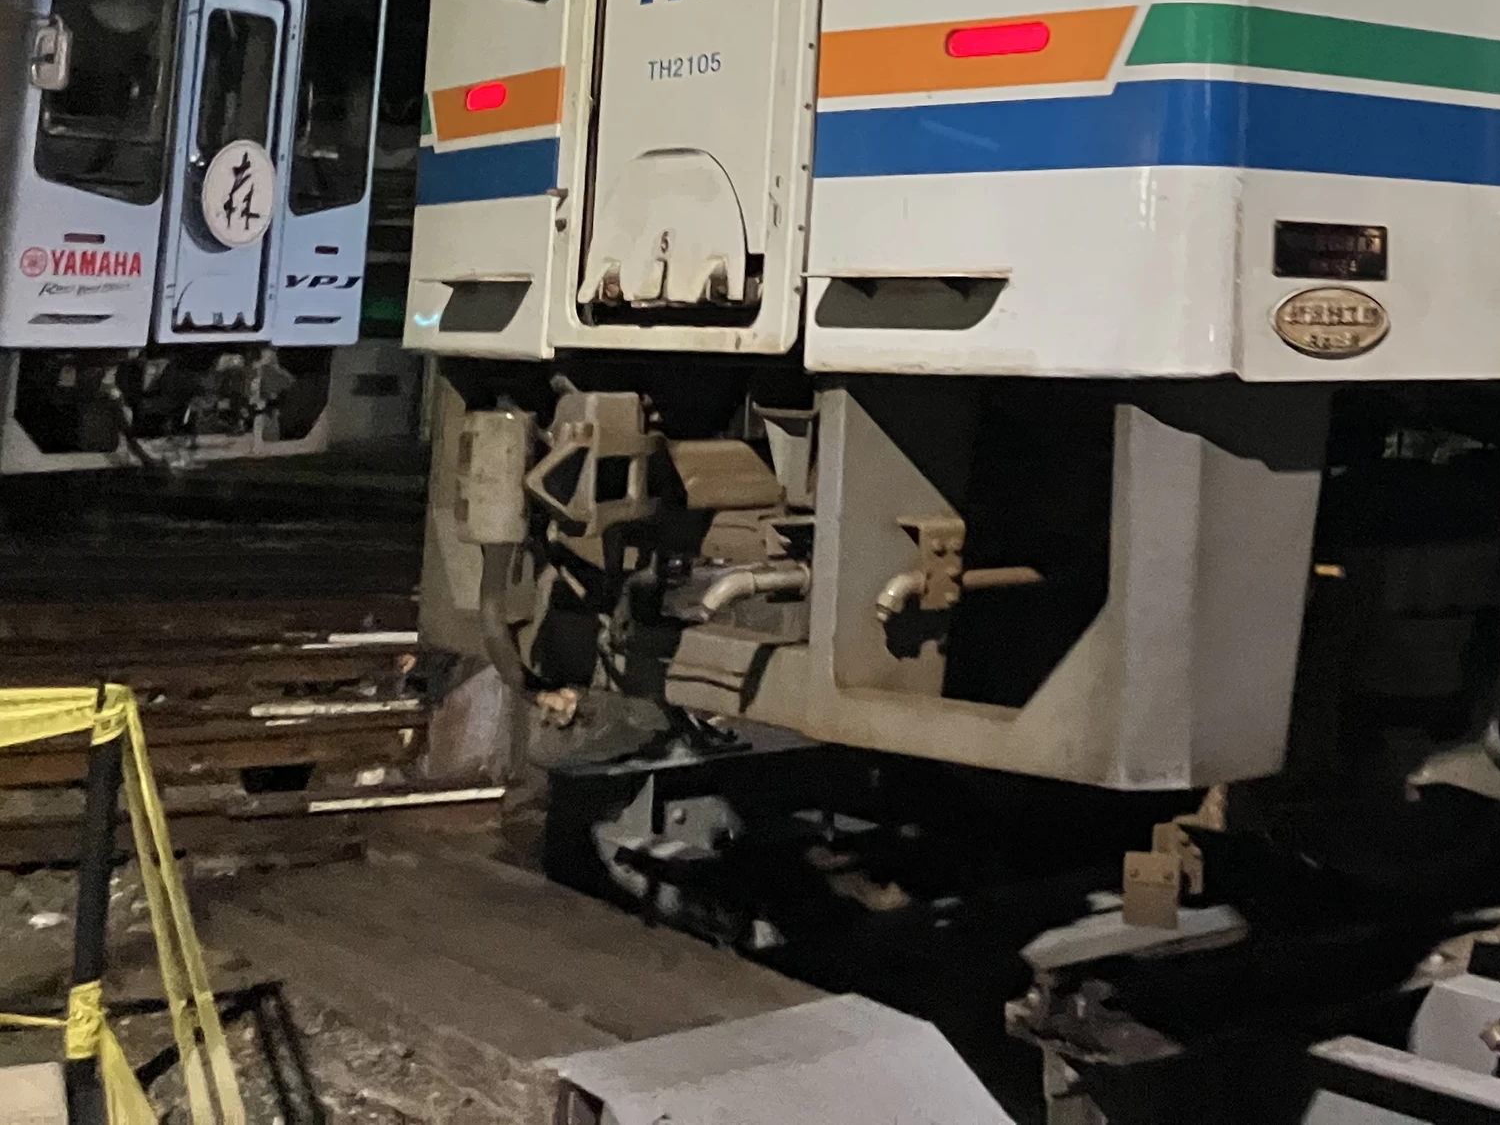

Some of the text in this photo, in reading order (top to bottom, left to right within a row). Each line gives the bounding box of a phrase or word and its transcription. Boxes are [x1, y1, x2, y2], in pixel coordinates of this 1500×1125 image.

[648, 52, 721, 81] TH2105
[51, 249, 142, 277] YAMAHA
[285, 275, 361, 288] YPJ
